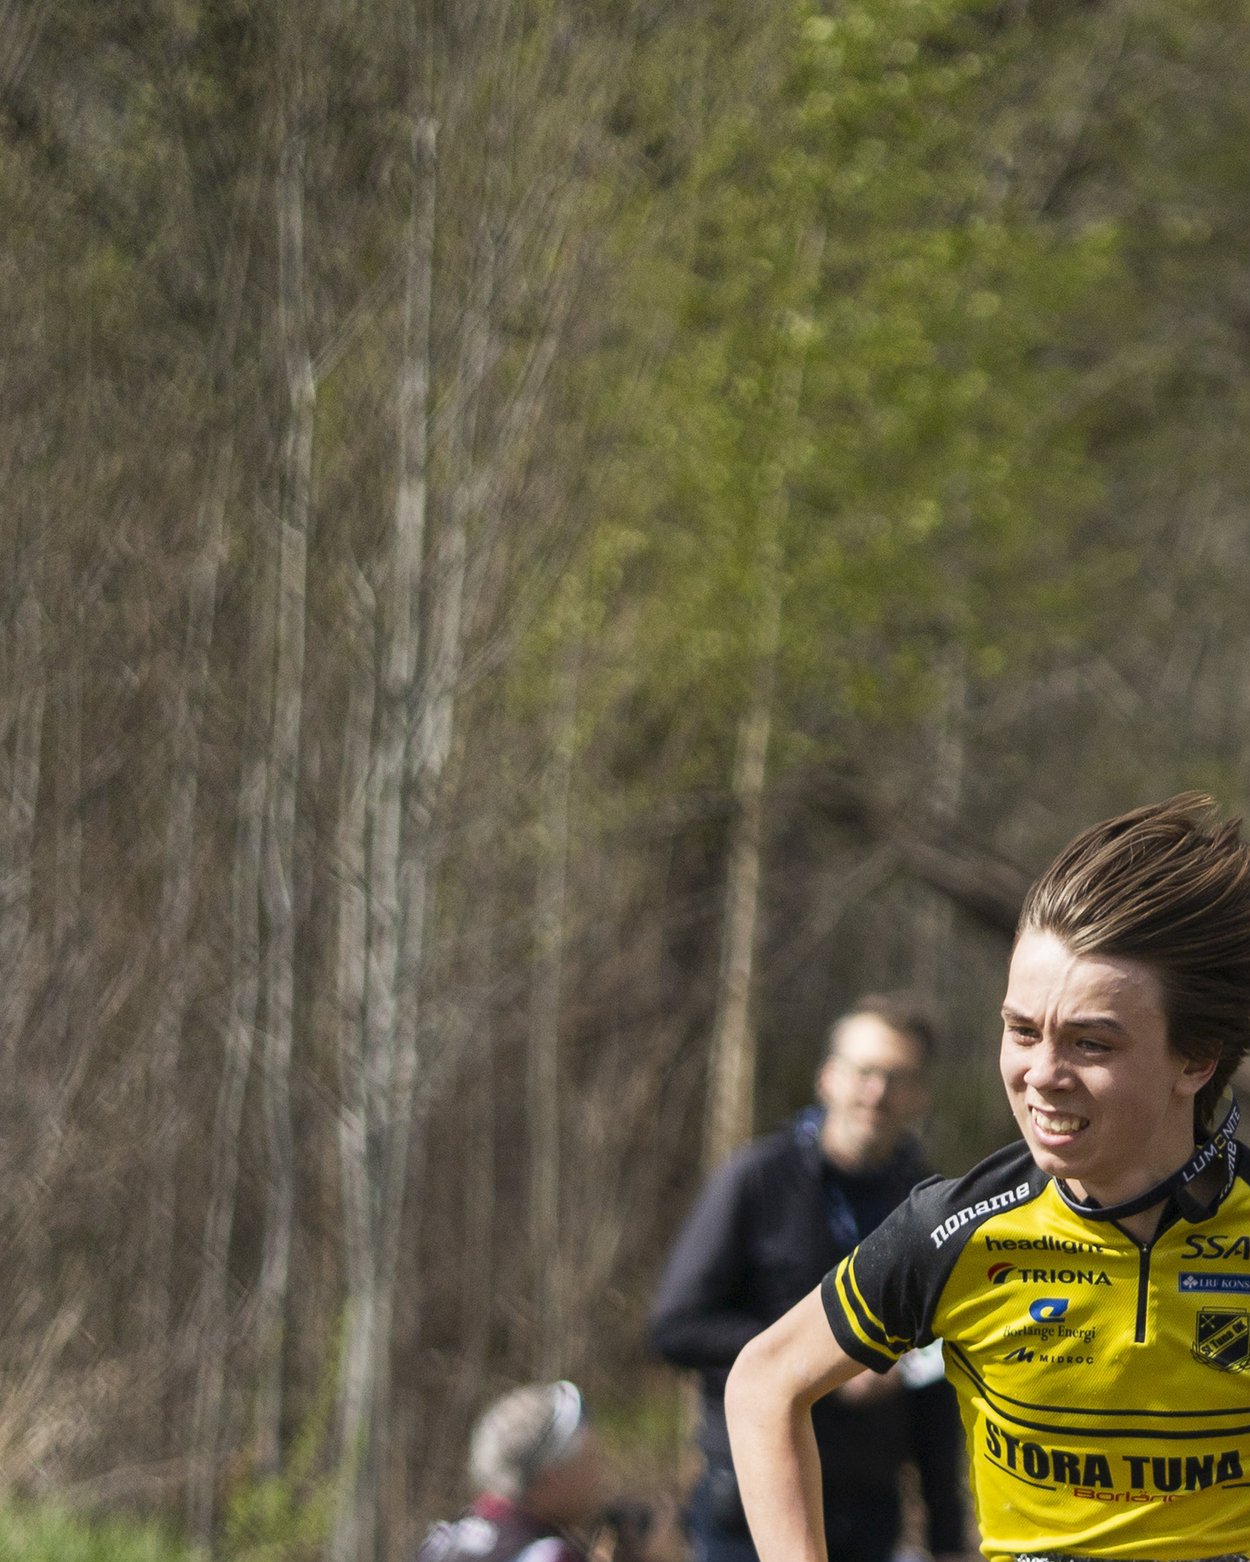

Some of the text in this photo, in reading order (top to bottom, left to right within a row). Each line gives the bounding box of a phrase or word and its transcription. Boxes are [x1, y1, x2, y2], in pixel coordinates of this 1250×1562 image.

[930, 1181, 1030, 1249] noname
[1018, 1268, 1112, 1287] TRIONA
[1058, 1325, 1096, 1344] Energi
[1040, 1354, 1094, 1364] MIDROC
[985, 1418, 1114, 1489] STORA
[1122, 1450, 1244, 1491] TUNA
